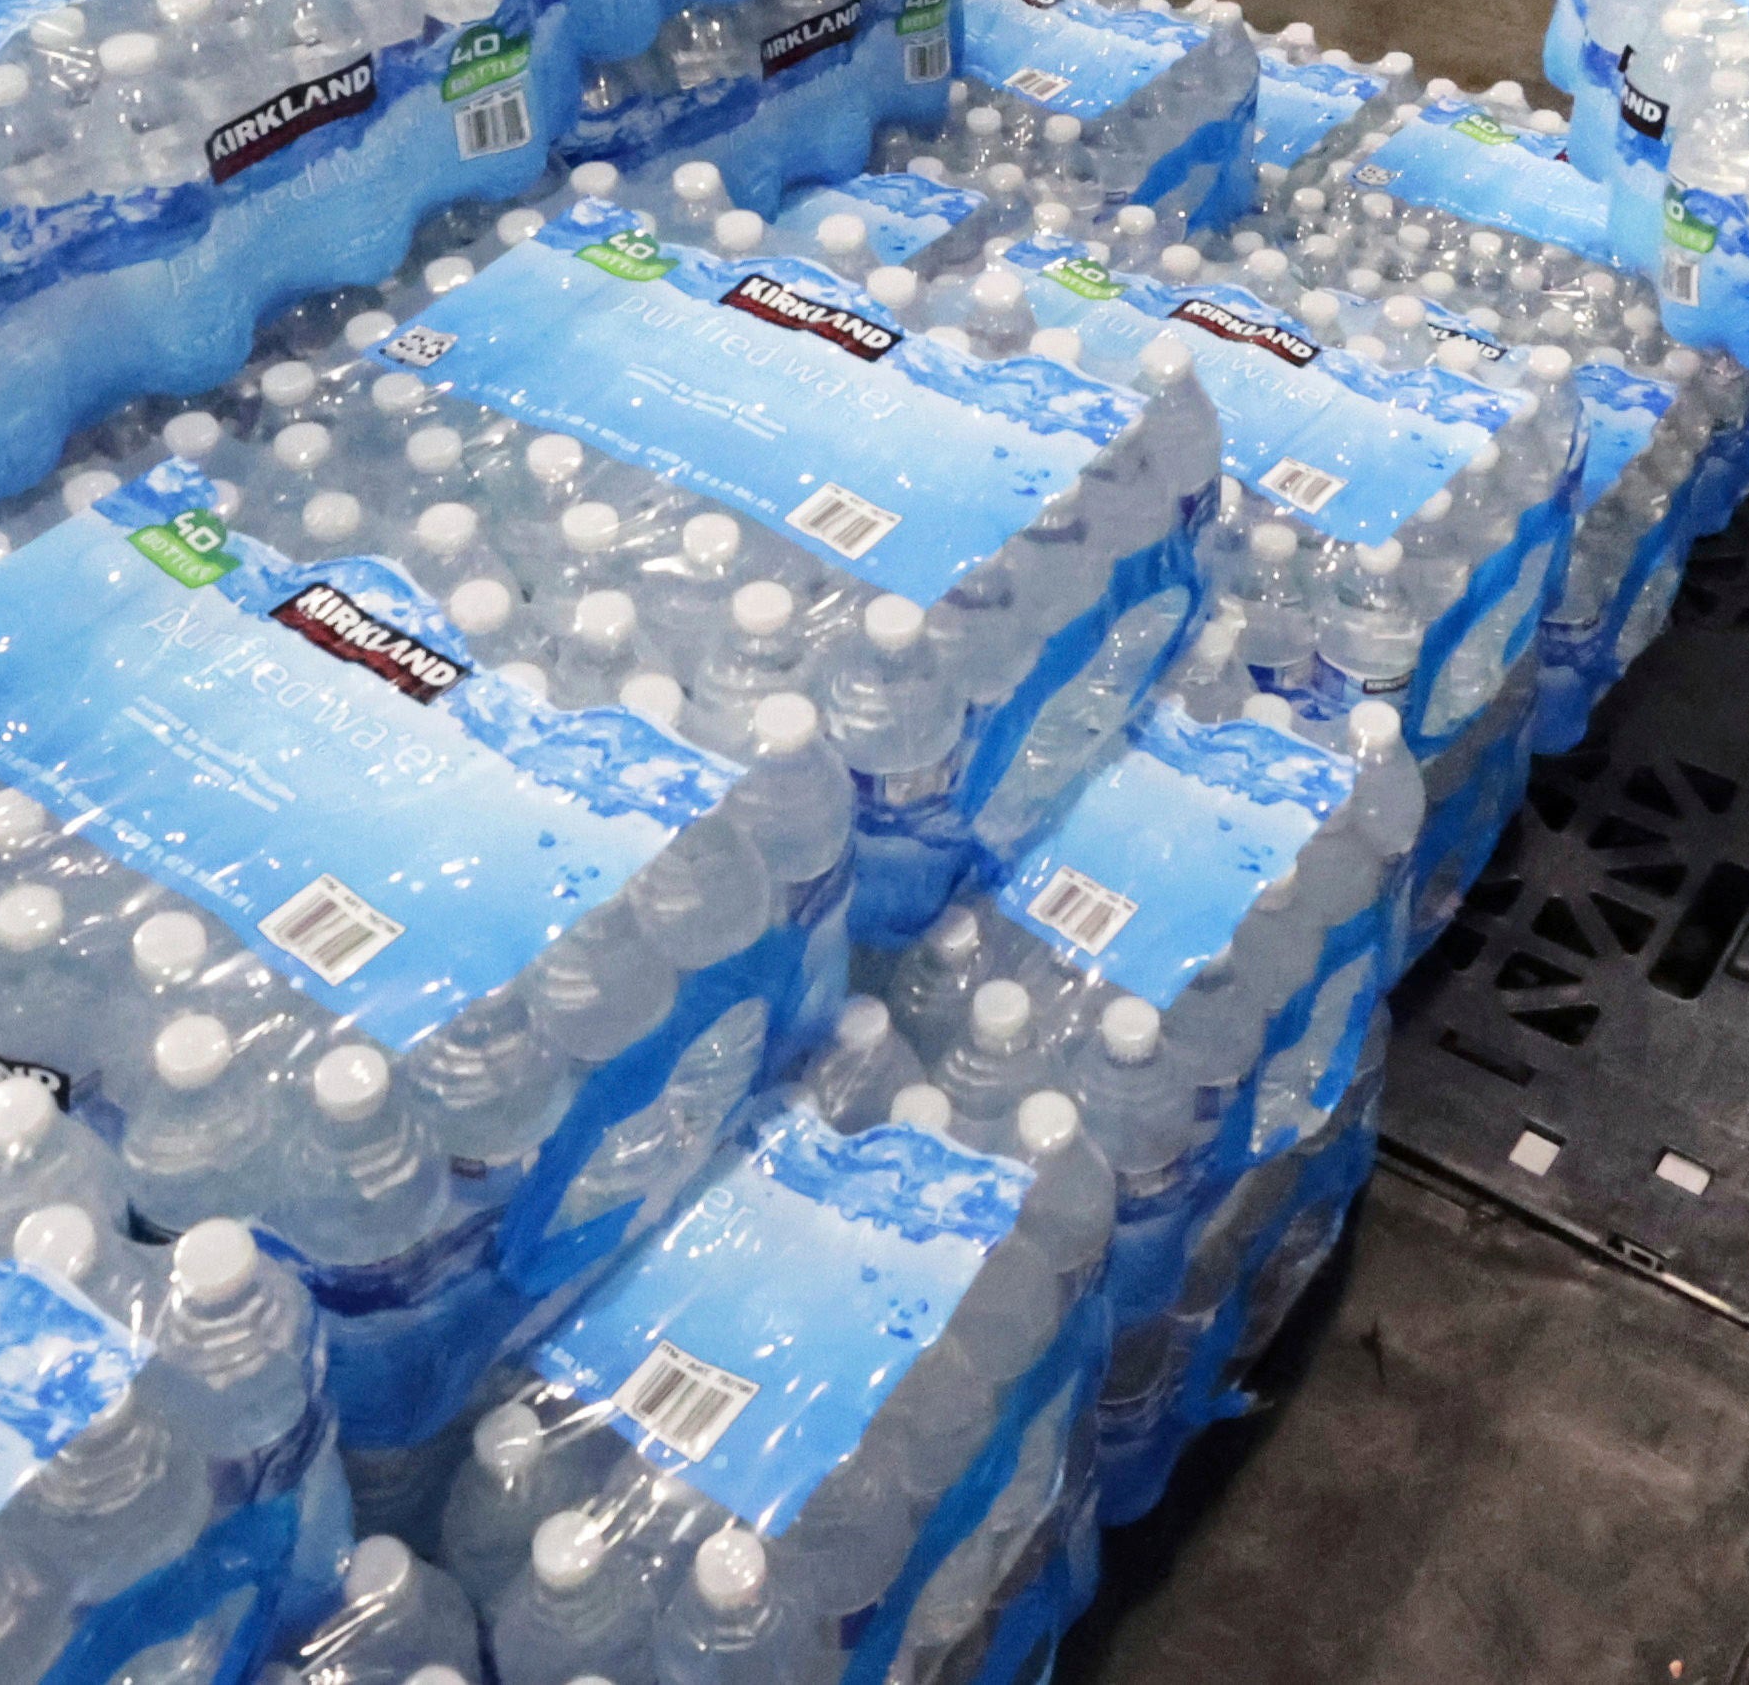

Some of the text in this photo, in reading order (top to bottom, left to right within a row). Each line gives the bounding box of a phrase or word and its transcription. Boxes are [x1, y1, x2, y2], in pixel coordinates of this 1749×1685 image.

[449, 32, 501, 69] 40
[210, 63, 372, 164] KIRKLAND
[1465, 115, 1502, 134] 40
[609, 229, 652, 258] 40
[1064, 257, 1107, 286] 40
[739, 277, 894, 351] KIRKLAND
[1183, 299, 1314, 363] KIRKLAND
[611, 295, 777, 369] purified
[783, 350, 911, 421] water
[1232, 352, 1333, 412] water
[139, 529, 213, 586] BOTTLES
[172, 509, 220, 554] 40
[139, 603, 312, 710] purified
[299, 583, 460, 689] KIRKLAND
